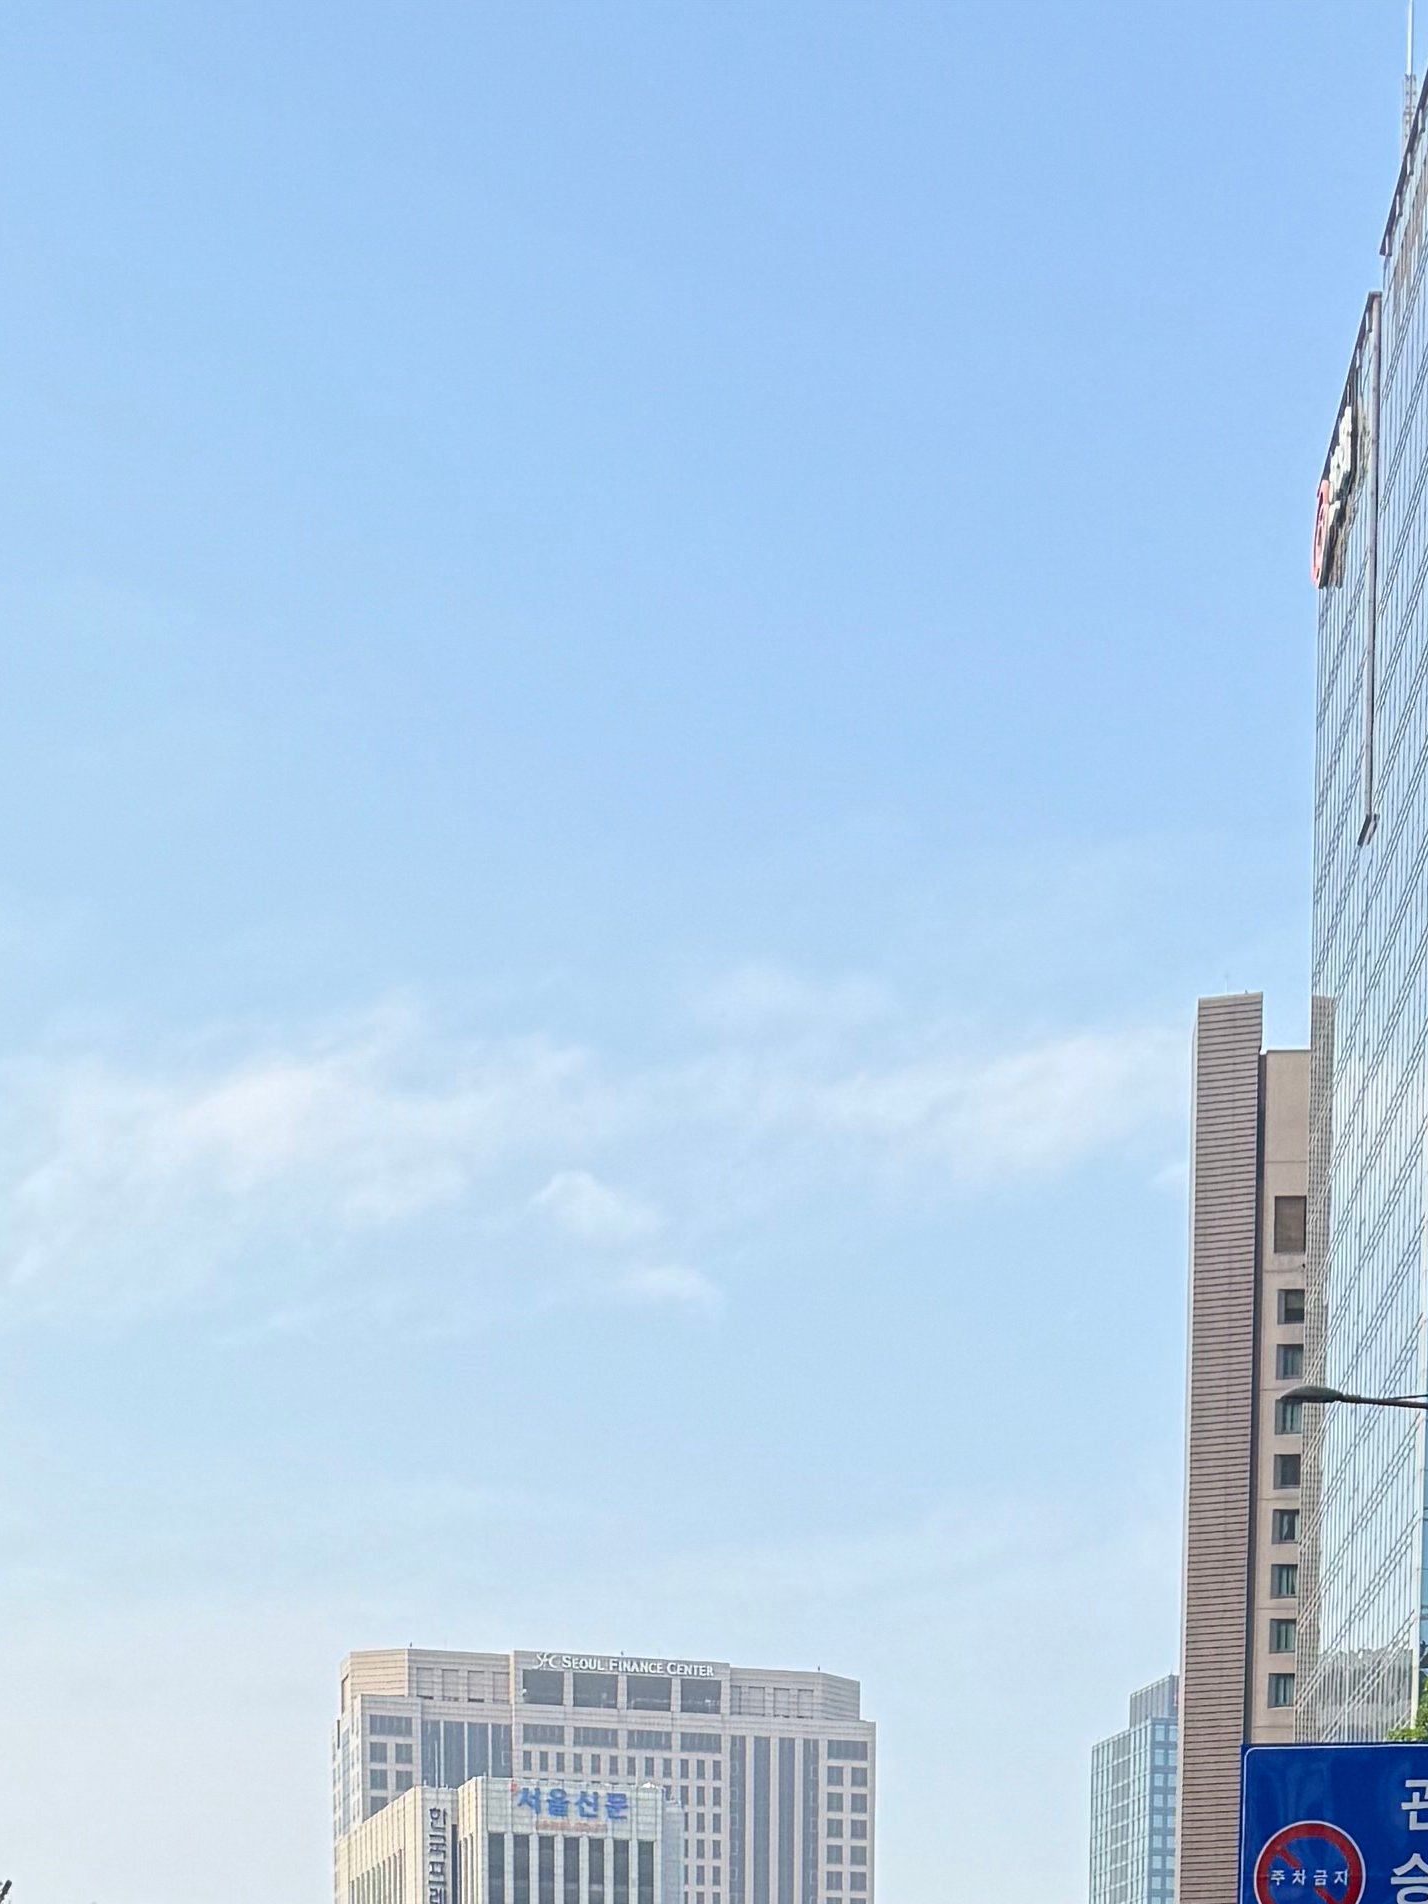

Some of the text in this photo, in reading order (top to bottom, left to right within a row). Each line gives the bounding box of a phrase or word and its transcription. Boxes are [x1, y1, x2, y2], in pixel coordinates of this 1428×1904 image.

[561, 1655, 605, 1672] SEOUL
[609, 1658, 664, 1675] FINANCE
[666, 1662, 714, 1677] CENTER
[518, 1787, 628, 1820] 서울신문
